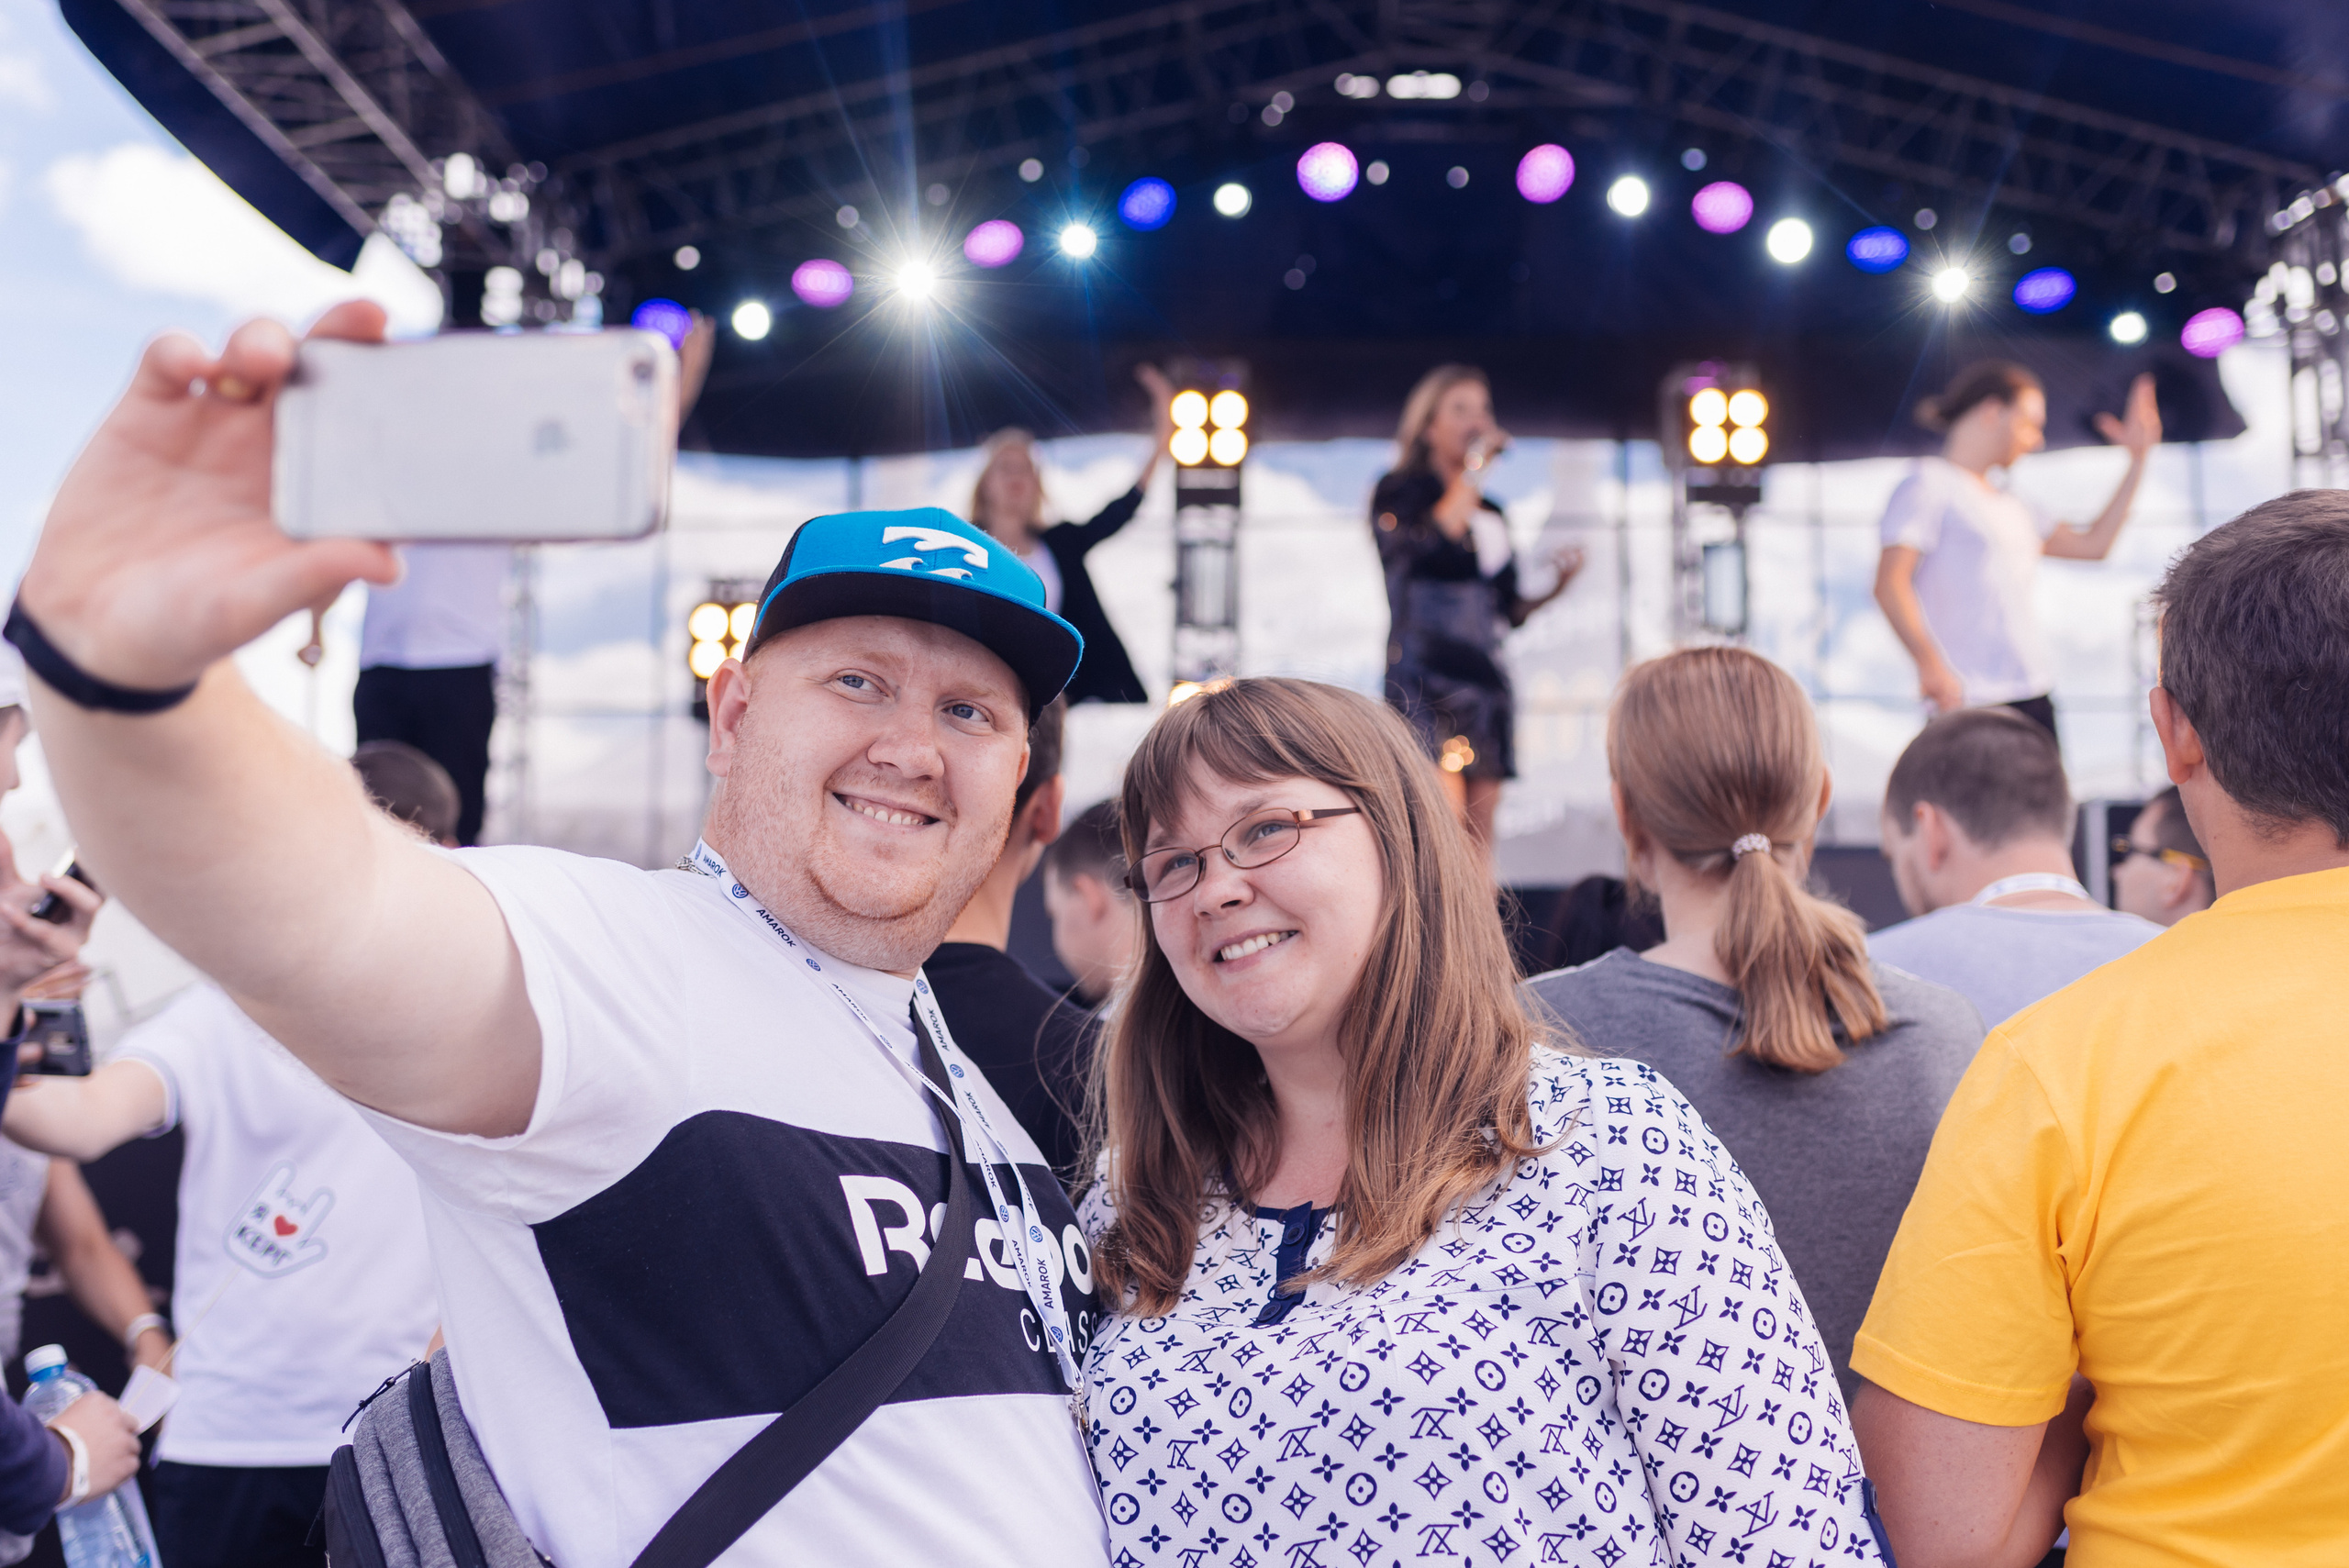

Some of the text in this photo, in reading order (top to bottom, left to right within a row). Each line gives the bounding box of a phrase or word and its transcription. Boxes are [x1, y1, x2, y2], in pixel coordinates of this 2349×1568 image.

[756, 908, 796, 948] AMAROK
[927, 1007, 951, 1052] AMAROK
[1012, 1240, 1032, 1288] AMAROK
[1036, 1258, 1054, 1309] AMAROK
